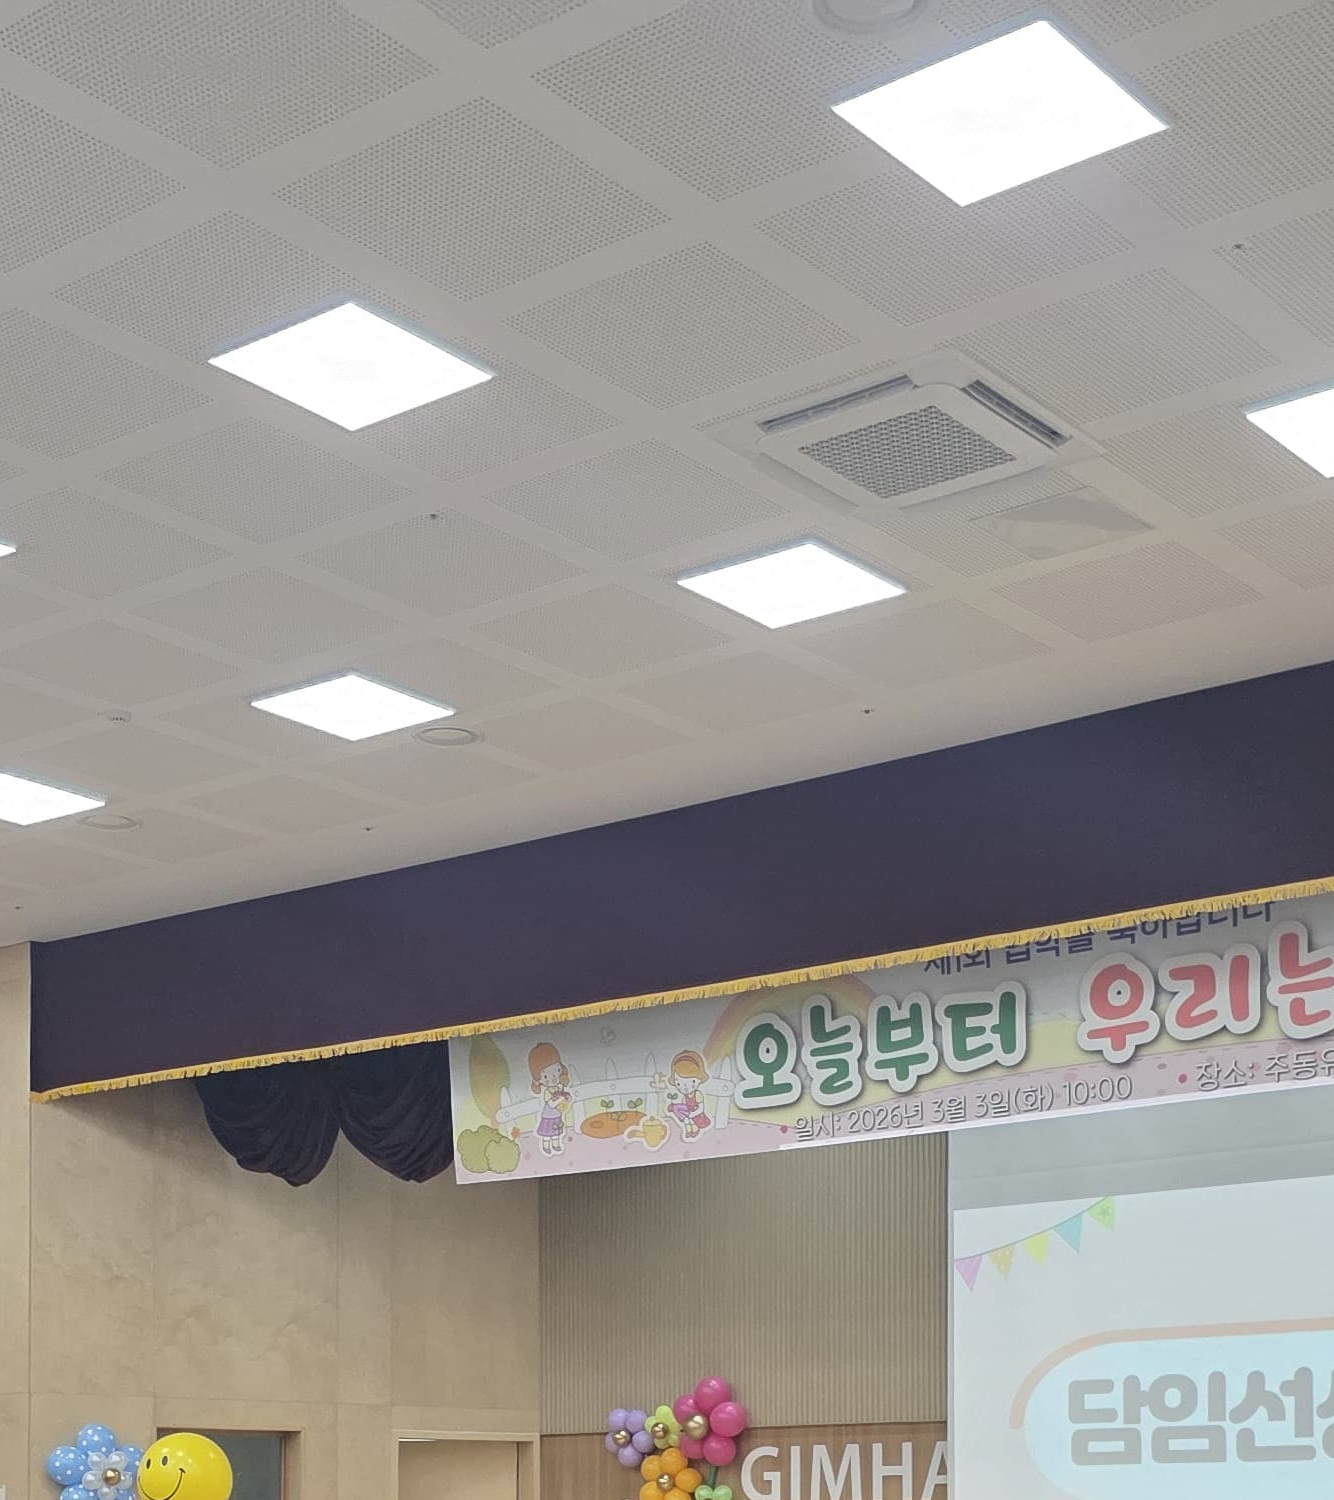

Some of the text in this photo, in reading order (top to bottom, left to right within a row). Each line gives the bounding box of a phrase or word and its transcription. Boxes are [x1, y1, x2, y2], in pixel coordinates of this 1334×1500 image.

[739, 986, 1024, 1100] 오늘부터
[1194, 1059, 1255, 1092] 장소:
[794, 1074, 1133, 1142] 일시: 2026년 3월 3일(화) 10:00
